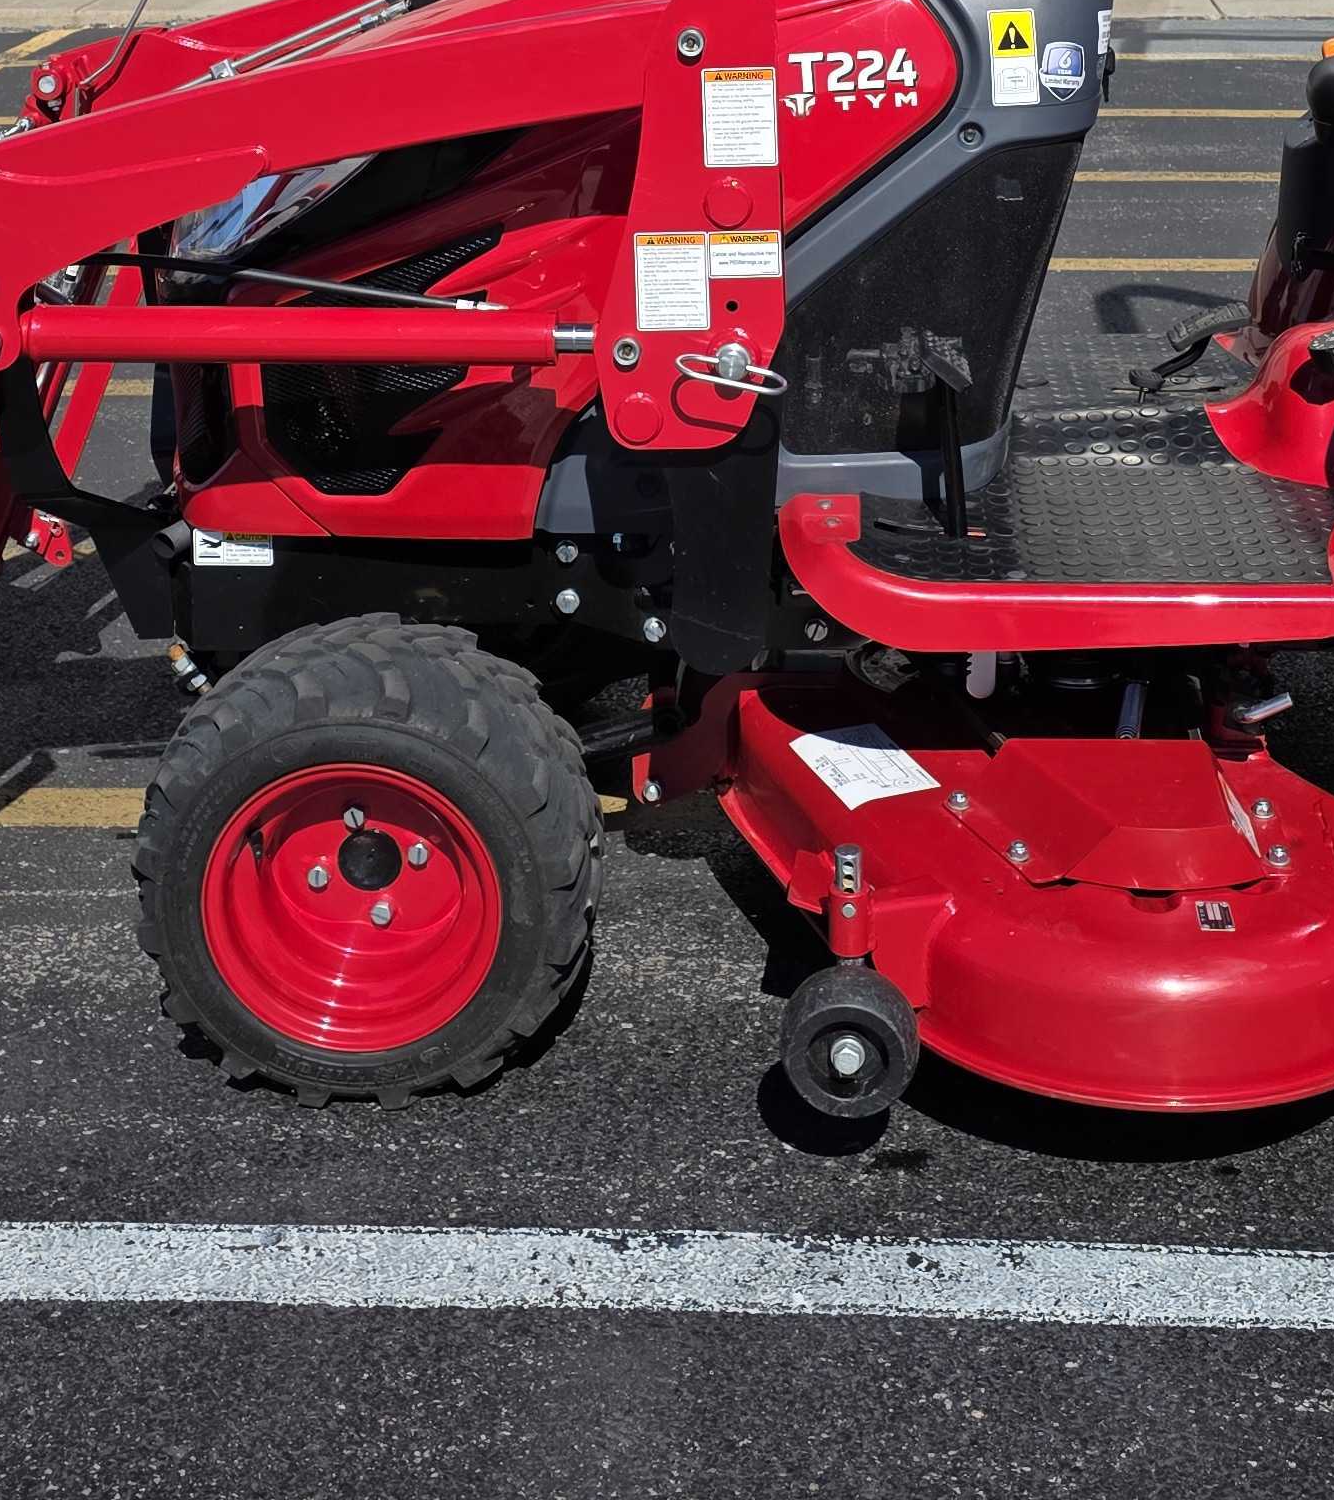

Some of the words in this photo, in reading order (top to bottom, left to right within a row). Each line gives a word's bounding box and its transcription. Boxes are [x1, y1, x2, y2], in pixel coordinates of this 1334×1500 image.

[1058, 50, 1072, 69] 6
[724, 71, 764, 80] WARNING
[787, 48, 918, 93] T224
[834, 93, 918, 111] TYM
[656, 236, 696, 245] WARNING
